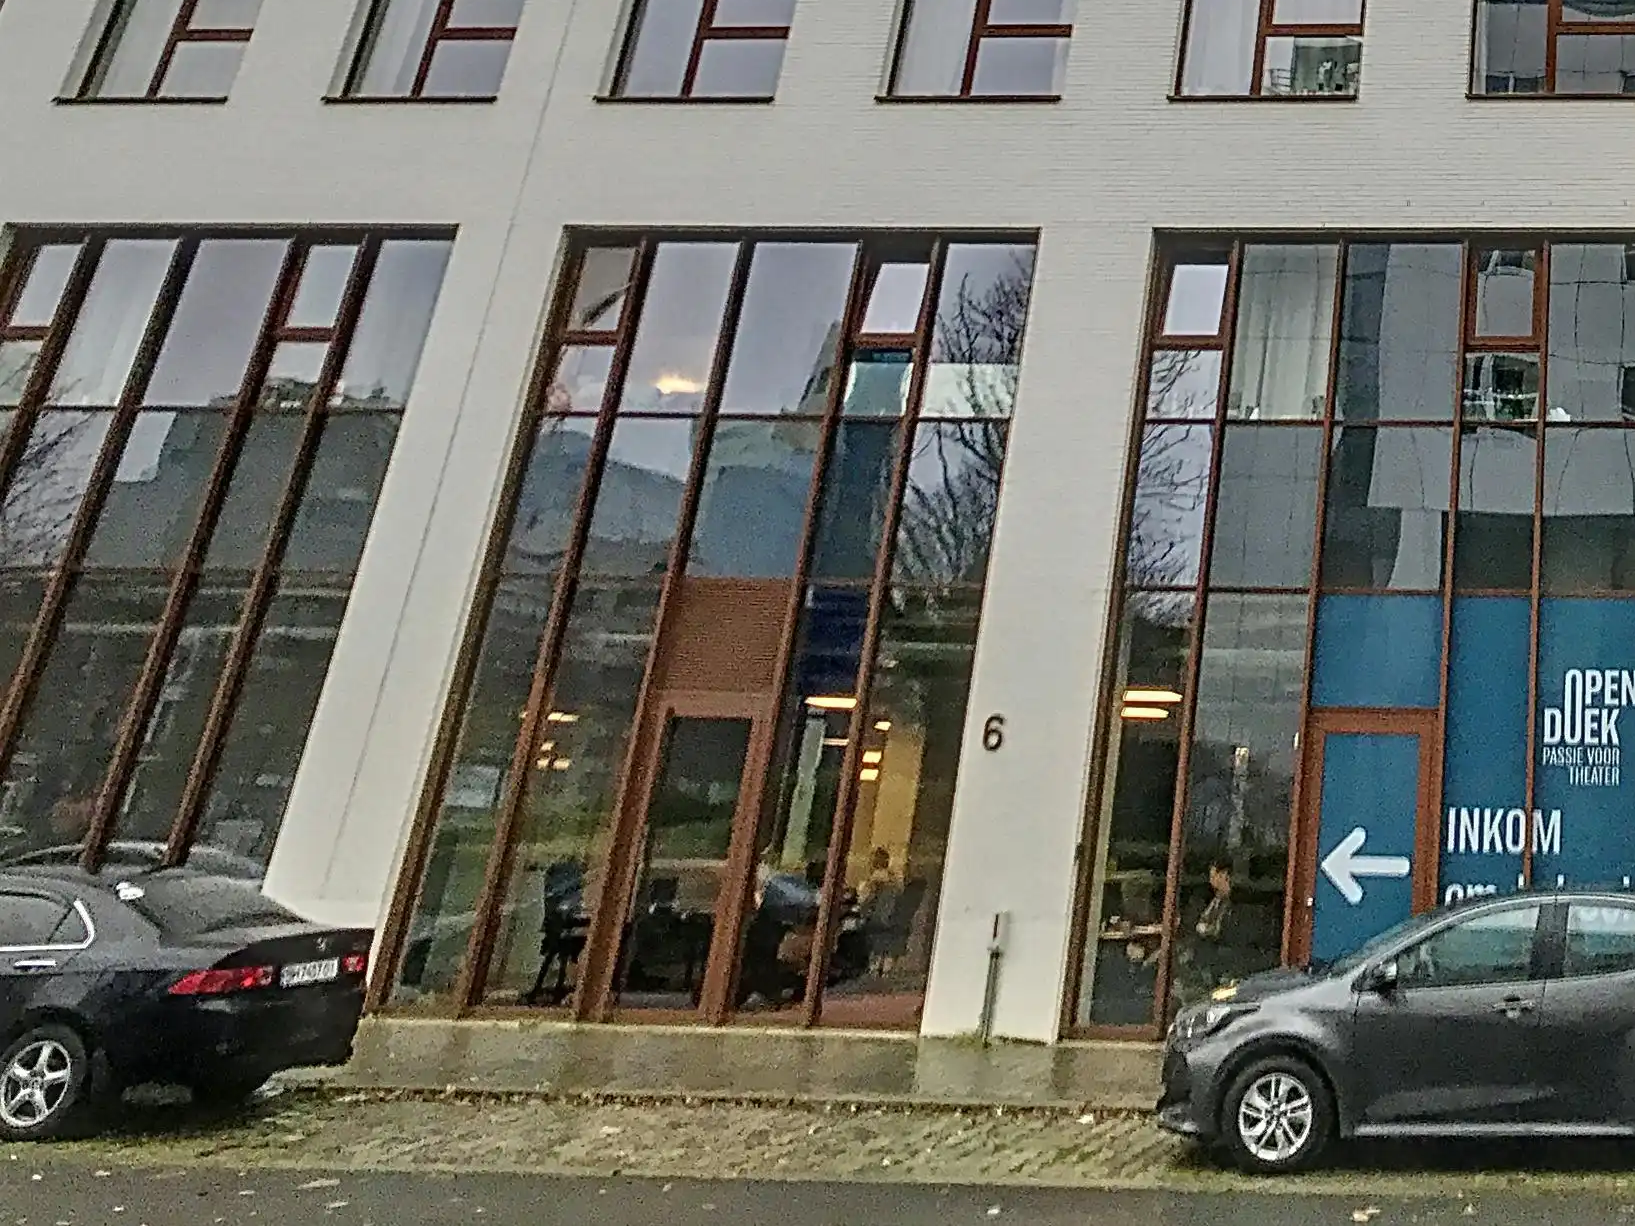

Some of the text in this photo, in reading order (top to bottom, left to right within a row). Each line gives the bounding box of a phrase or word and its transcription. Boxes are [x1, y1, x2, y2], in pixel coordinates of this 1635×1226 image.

[983, 715, 1003, 752] 6
[1543, 706, 1620, 746] DOEK
[1542, 746, 1620, 766] PASSIE VOOR
[1569, 766, 1620, 786] THEATER
[1447, 806, 1561, 855] INKOM
